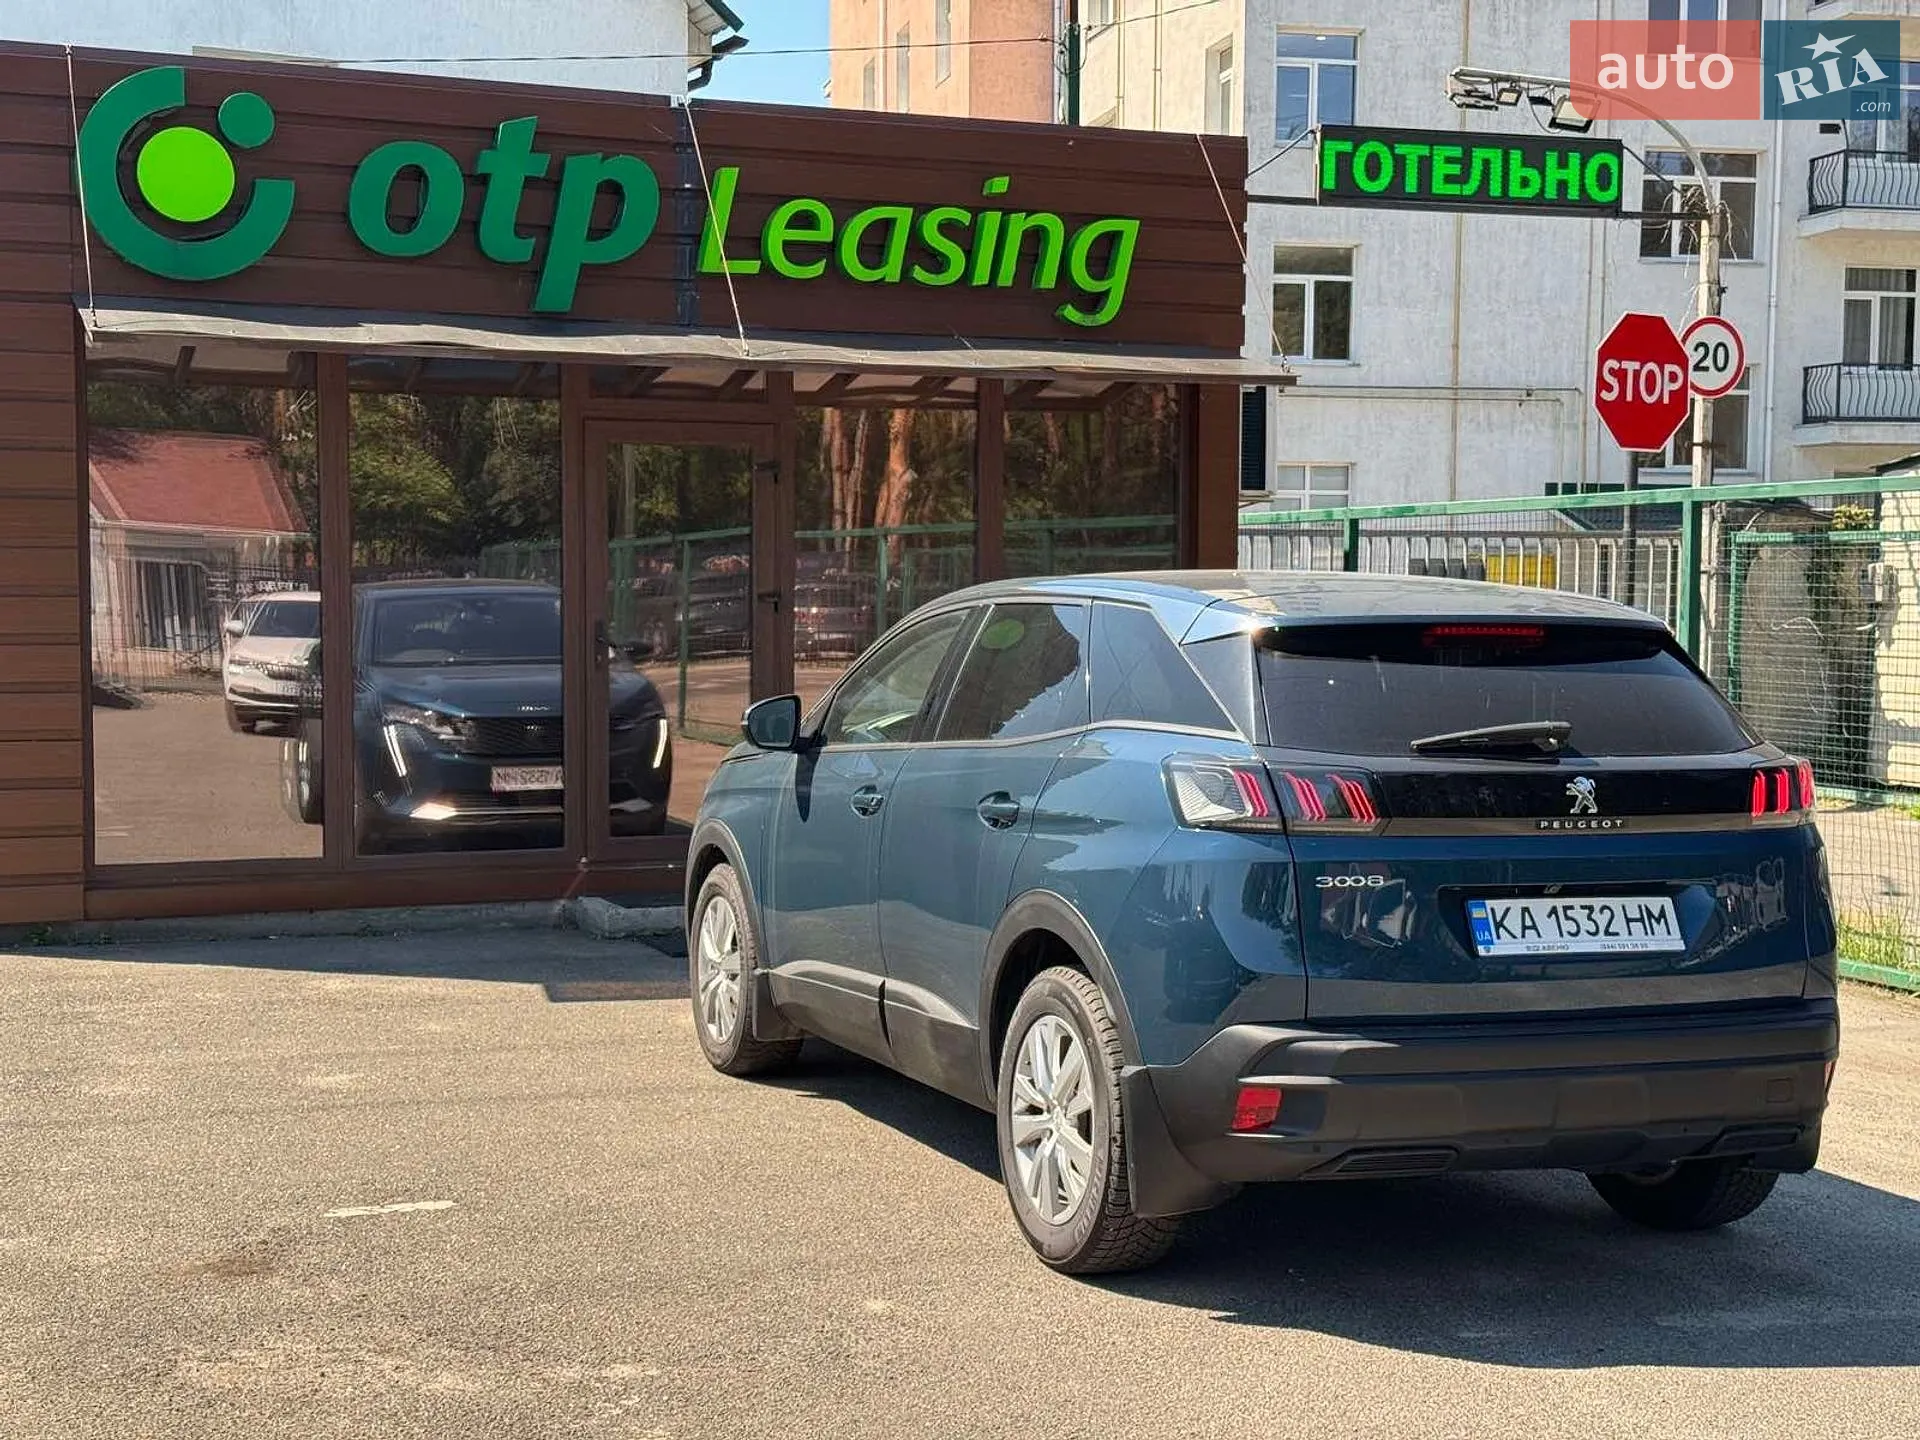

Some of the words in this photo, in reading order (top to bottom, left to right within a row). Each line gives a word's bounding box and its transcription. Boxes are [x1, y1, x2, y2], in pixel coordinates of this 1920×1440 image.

[1321, 139, 1620, 203] ГОТЕЛЬНО
[349, 116, 660, 313] otp
[698, 166, 1140, 327] Leasing
[1693, 341, 1730, 373] 20
[1600, 358, 1684, 404] STOP
[1540, 818, 1624, 829] PEUGEOT
[1314, 874, 1385, 888] 3008
[1476, 930, 1492, 941] UA
[1546, 904, 1621, 938] 1532
